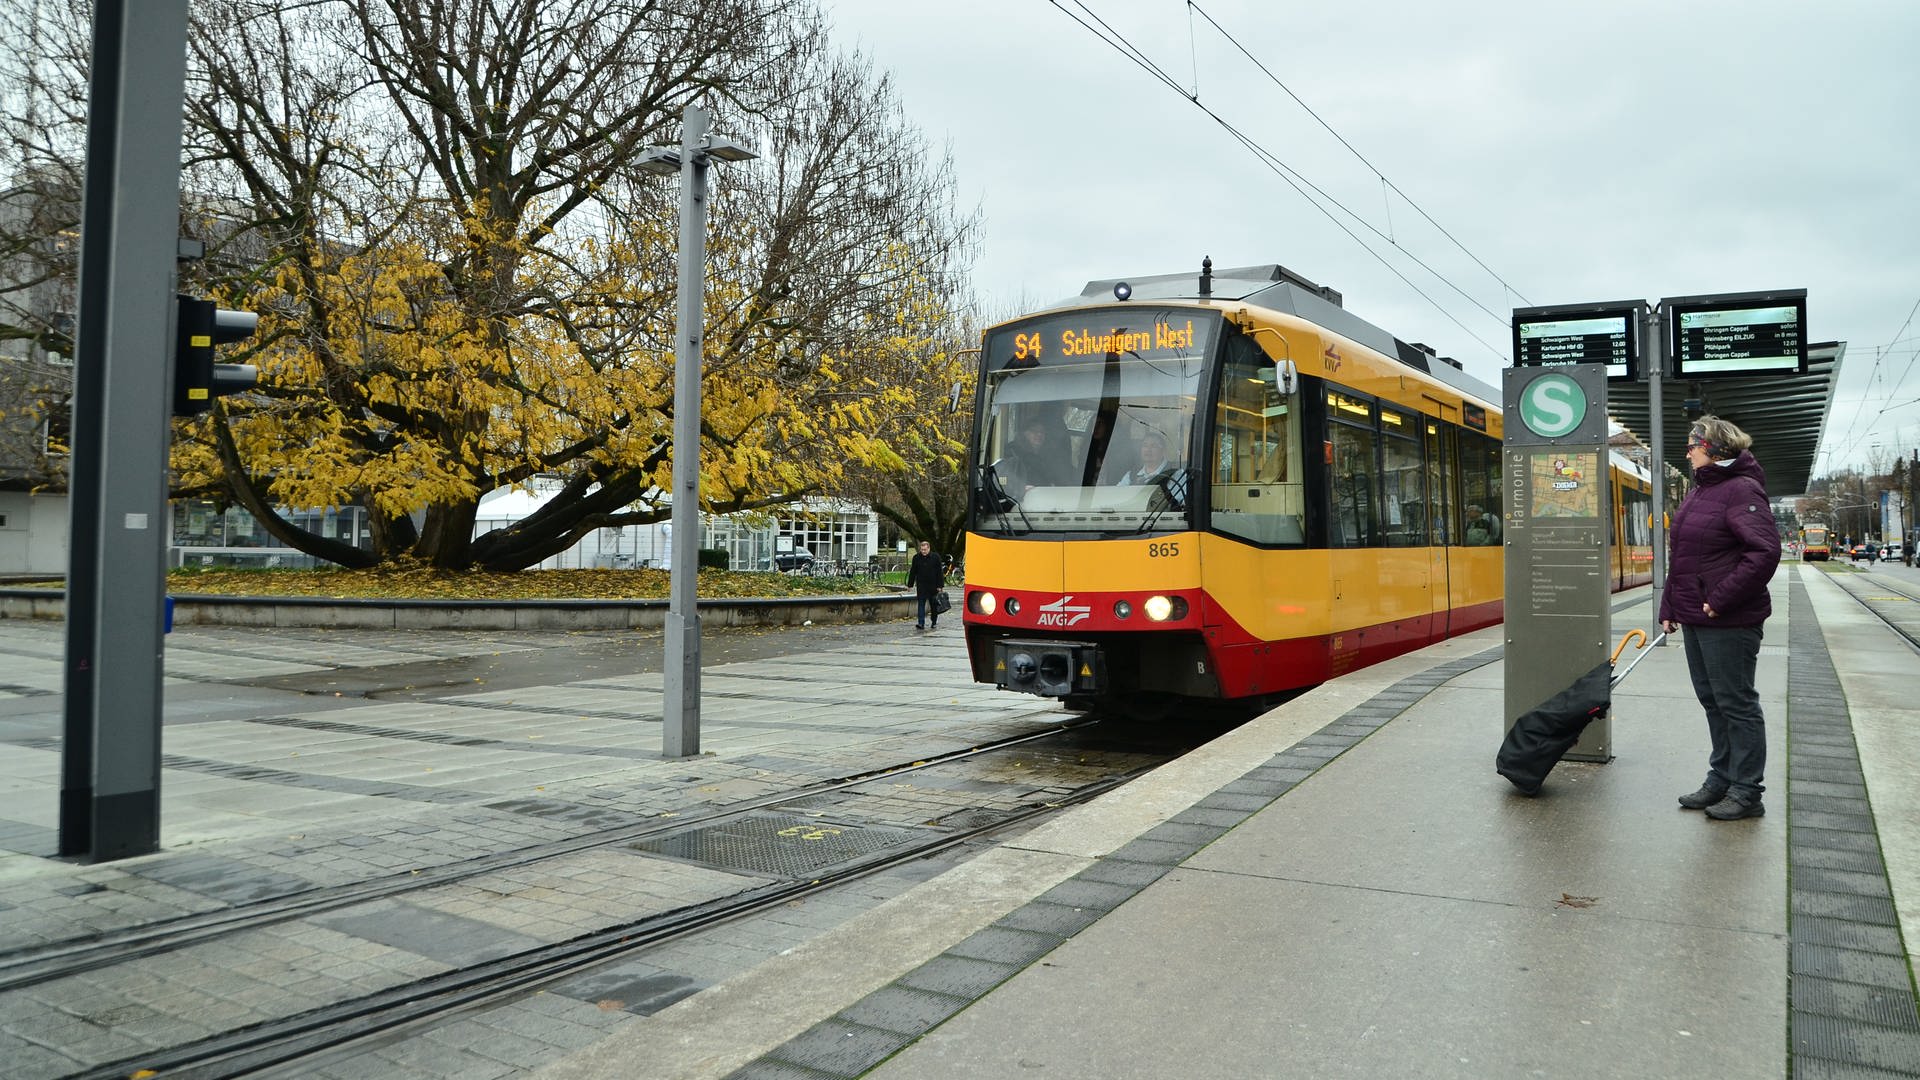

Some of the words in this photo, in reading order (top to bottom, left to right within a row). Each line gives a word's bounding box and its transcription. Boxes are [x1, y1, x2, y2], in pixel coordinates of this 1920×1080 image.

[1015, 332, 1042, 360] S4
[1062, 328, 1150, 356] Schwaigern
[1155, 320, 1194, 349] West
[1533, 381, 1573, 432] S
[1510, 454, 1524, 529] Harmonie
[1149, 542, 1180, 558] 865
[1037, 613, 1069, 626] AVG
[1197, 661, 1205, 674] B
